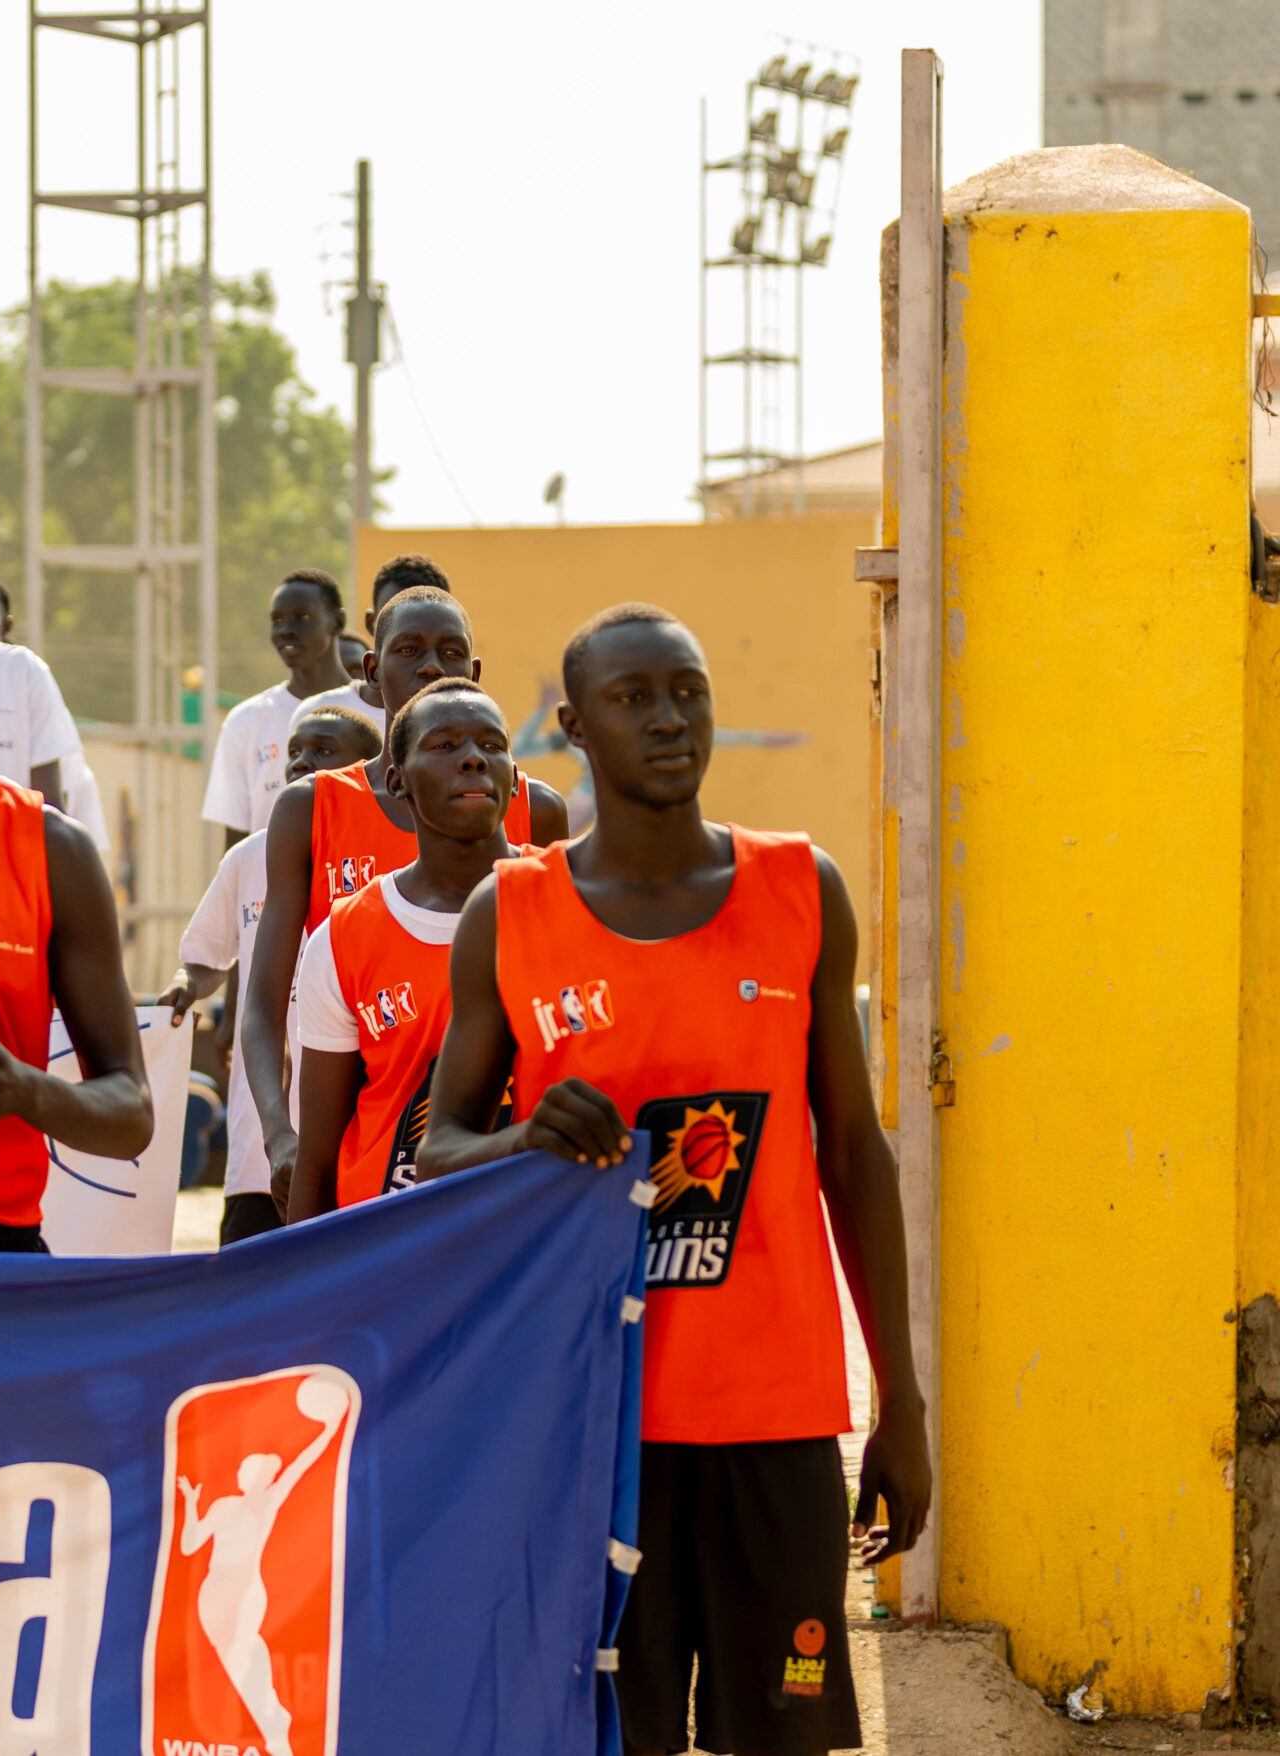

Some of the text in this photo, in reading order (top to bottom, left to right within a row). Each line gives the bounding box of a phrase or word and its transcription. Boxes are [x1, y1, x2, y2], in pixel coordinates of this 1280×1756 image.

[325, 861, 341, 903] jr.
[357, 1001, 386, 1041] jr.
[532, 997, 570, 1052] jr.
[646, 1220, 731, 1240] OENIX
